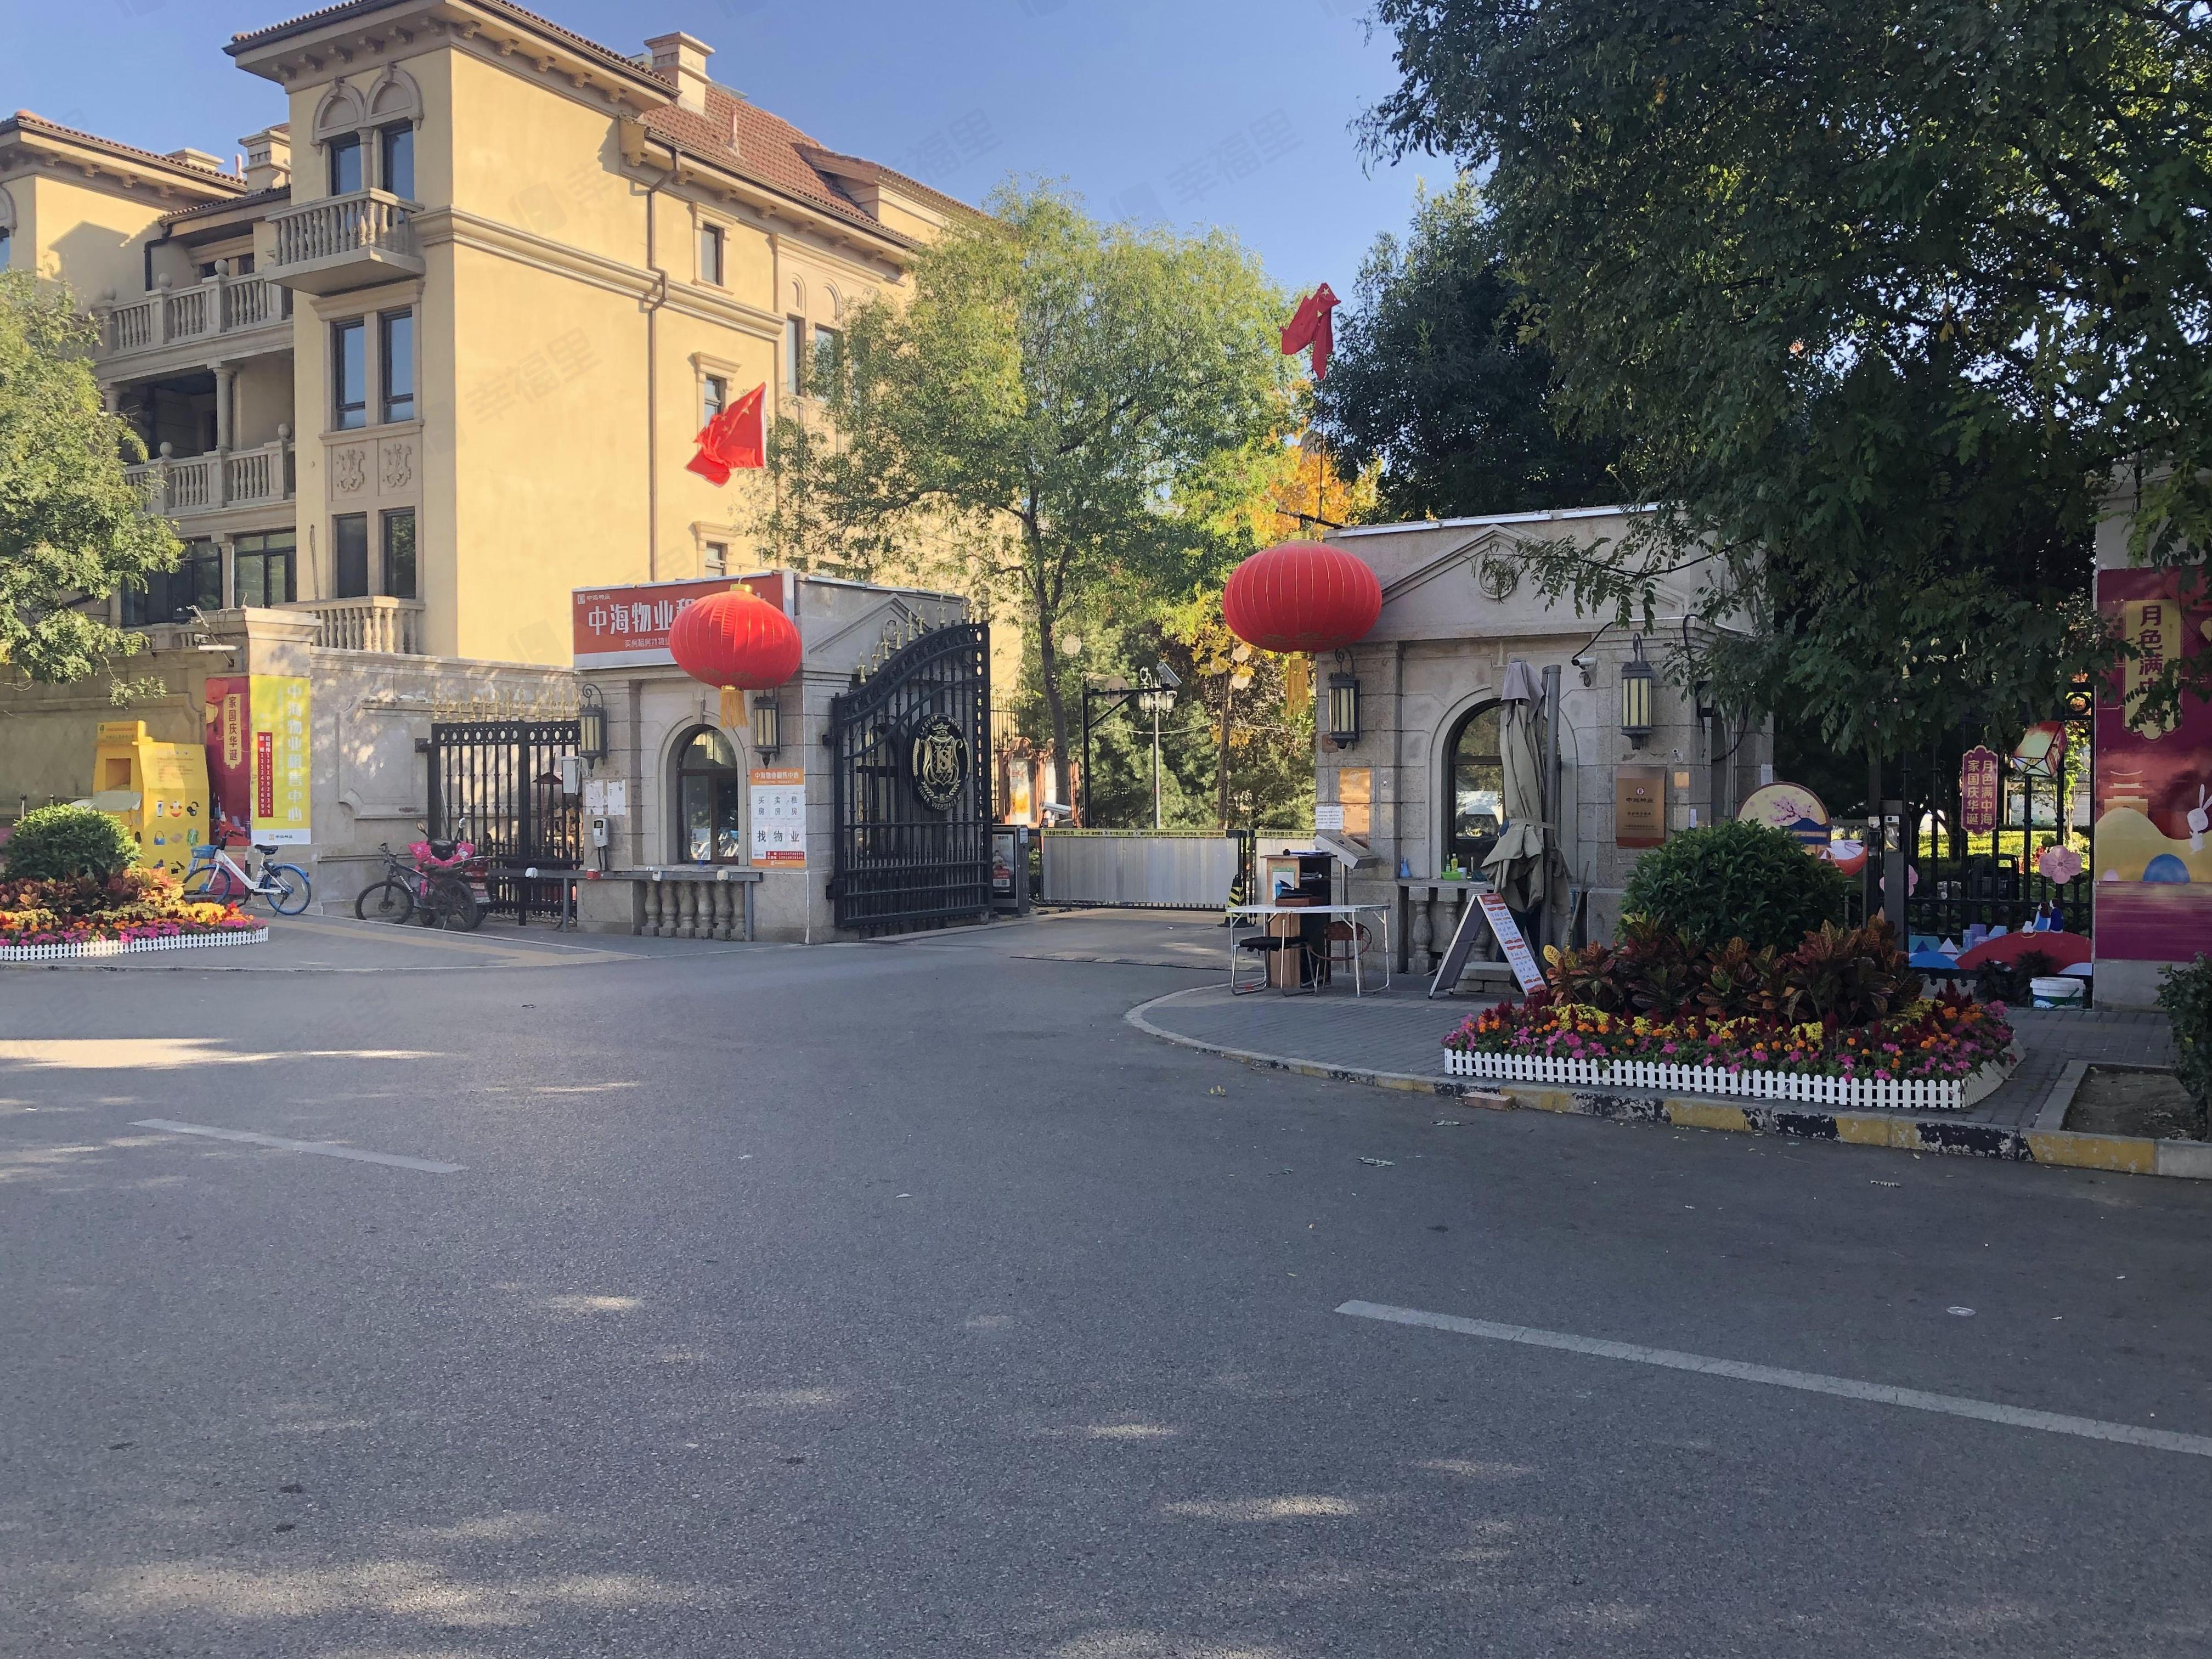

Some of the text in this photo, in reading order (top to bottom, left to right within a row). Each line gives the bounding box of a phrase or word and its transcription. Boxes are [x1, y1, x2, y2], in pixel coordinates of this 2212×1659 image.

[228, 696, 238, 761] 家国庆华诞
[1966, 760, 1980, 825] 家国庆华诞
[1980, 760, 1995, 825] 月色满中海
